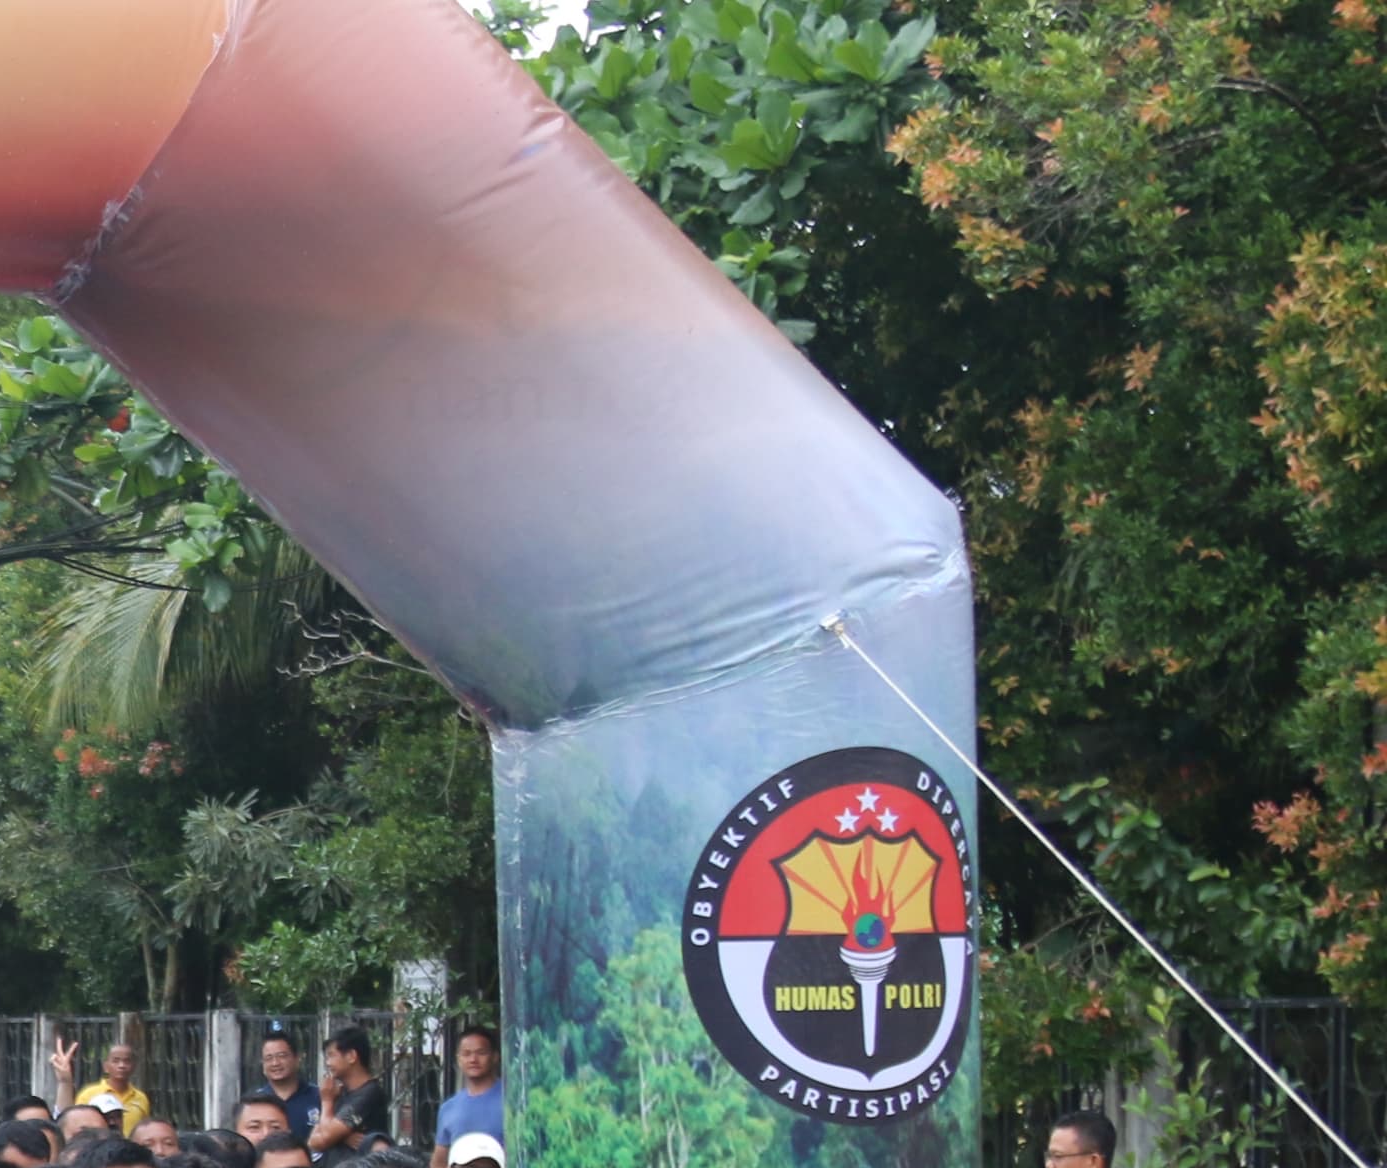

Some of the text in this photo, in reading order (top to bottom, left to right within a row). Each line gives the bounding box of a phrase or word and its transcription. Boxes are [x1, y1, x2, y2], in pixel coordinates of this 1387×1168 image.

[690, 778, 796, 947] OBYEKTIF
[774, 983, 942, 1012] HUMAS POLRI
[759, 1059, 951, 1118] PARTISIPASI
